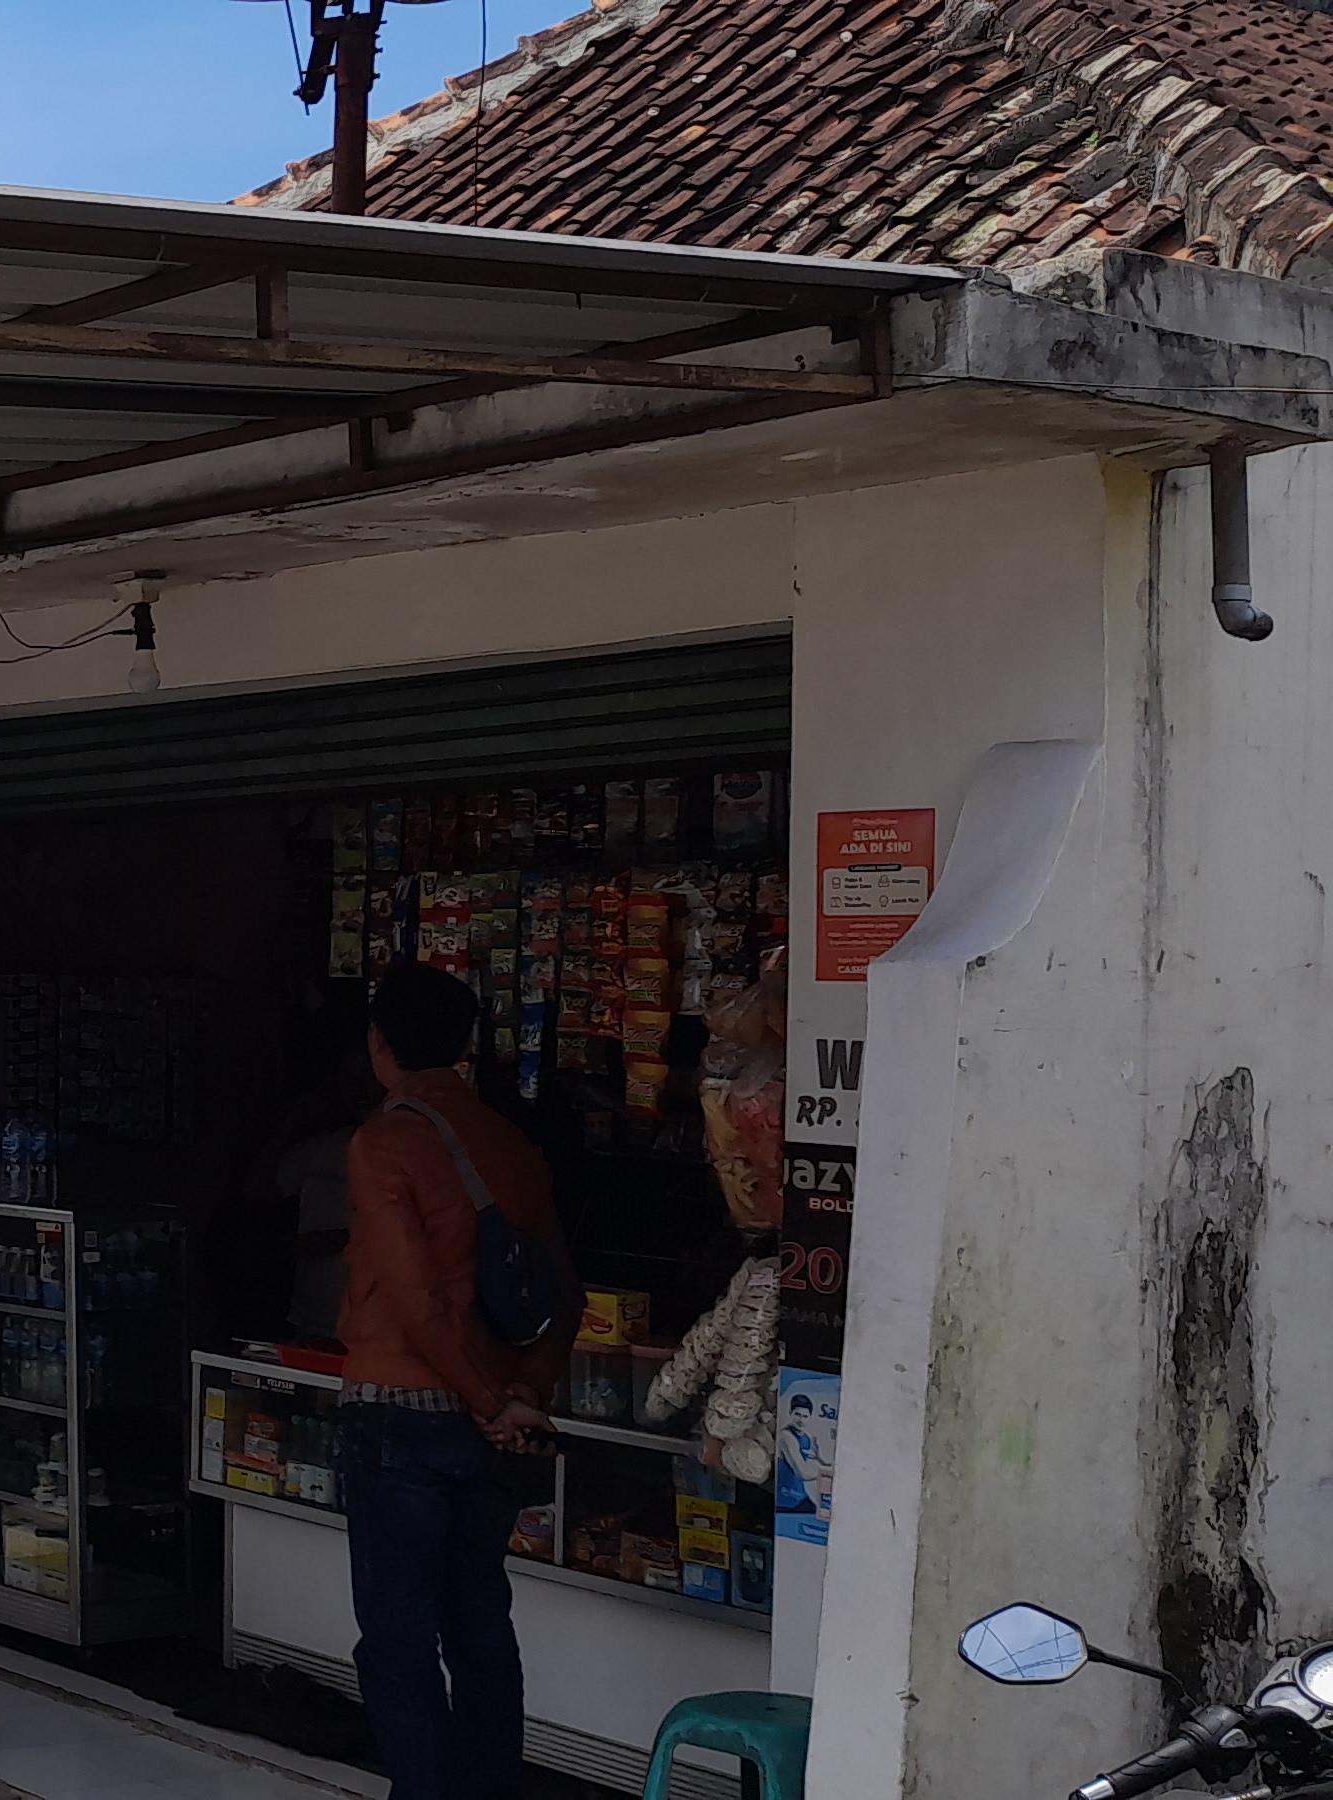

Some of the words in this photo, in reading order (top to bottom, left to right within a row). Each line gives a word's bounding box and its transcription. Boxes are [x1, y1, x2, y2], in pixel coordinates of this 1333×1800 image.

[853, 829, 898, 841] SEMUA
[839, 843, 868, 854] ADA
[870, 842, 883, 853] DI
[886, 841, 912, 853] SINI
